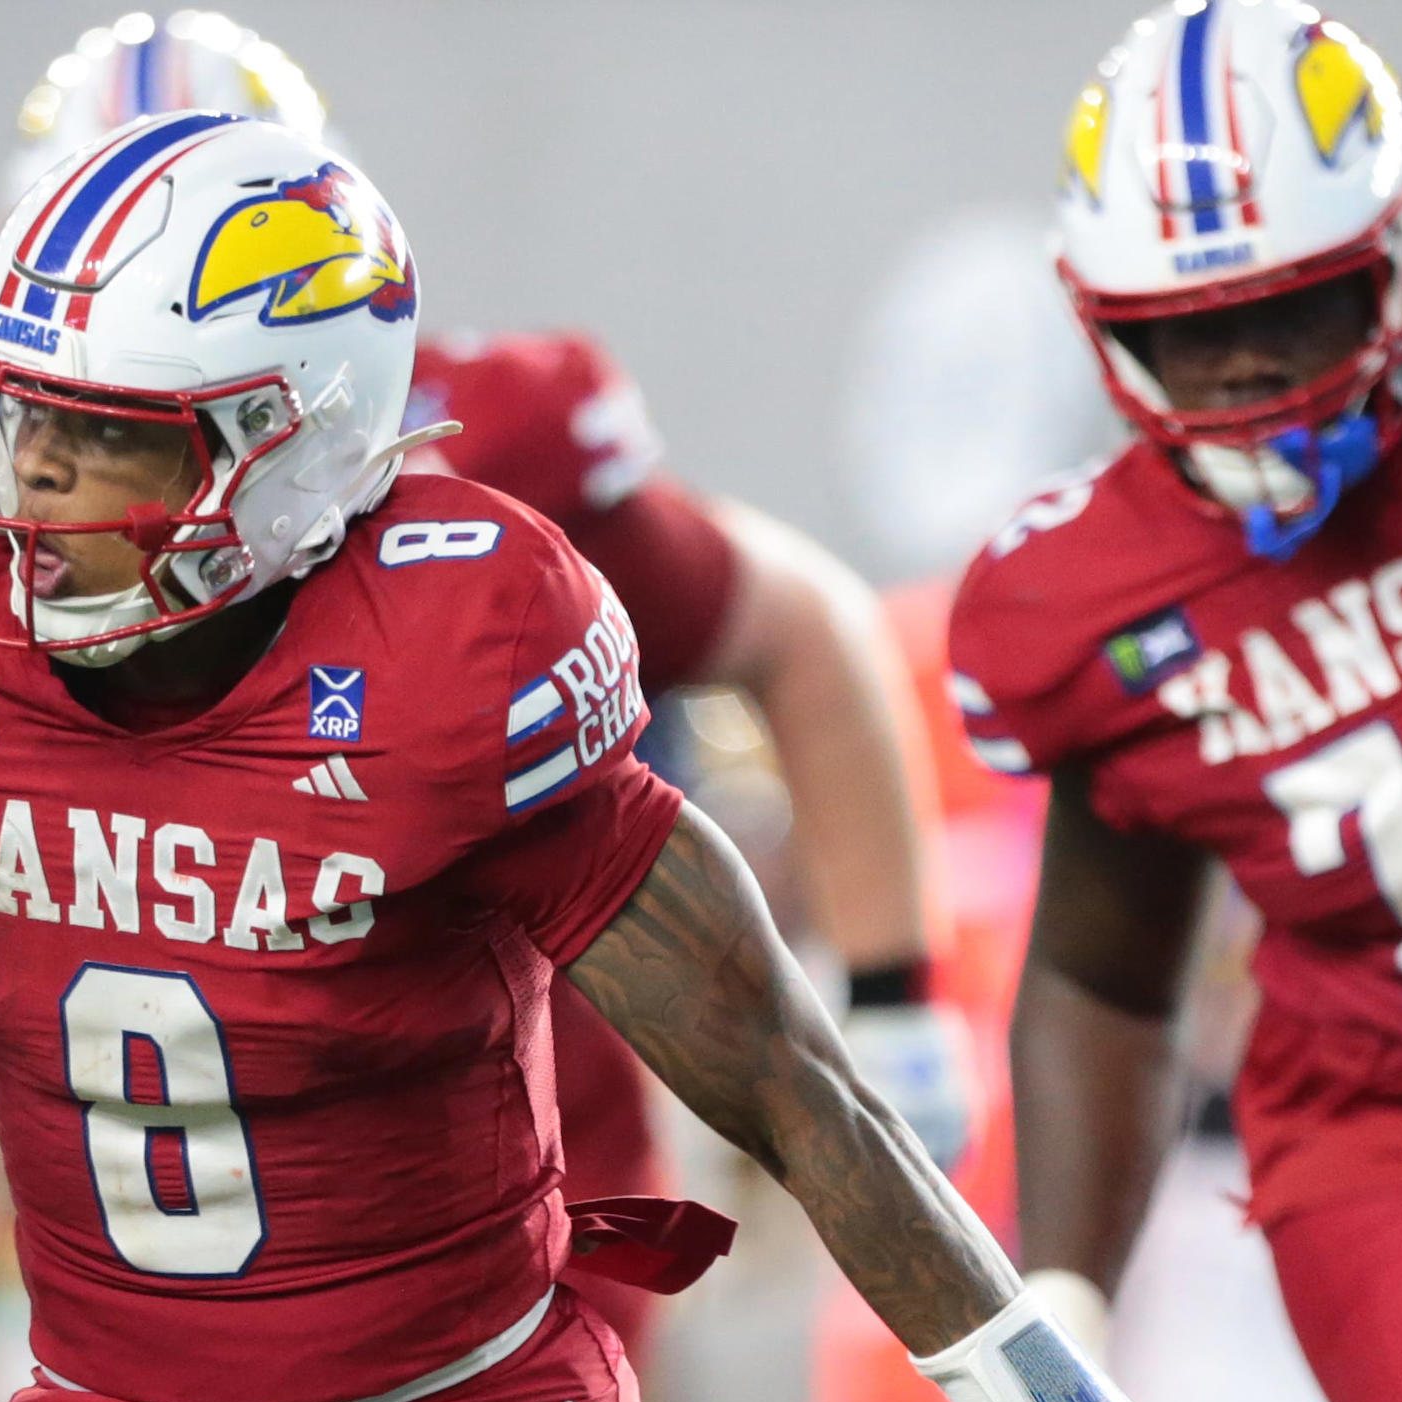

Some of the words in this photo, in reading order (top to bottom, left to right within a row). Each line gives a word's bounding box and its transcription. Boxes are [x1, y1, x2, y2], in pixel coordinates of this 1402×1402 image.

[377, 519, 506, 570] 8
[311, 715, 359, 738] XRP
[59, 959, 267, 1280] 8
